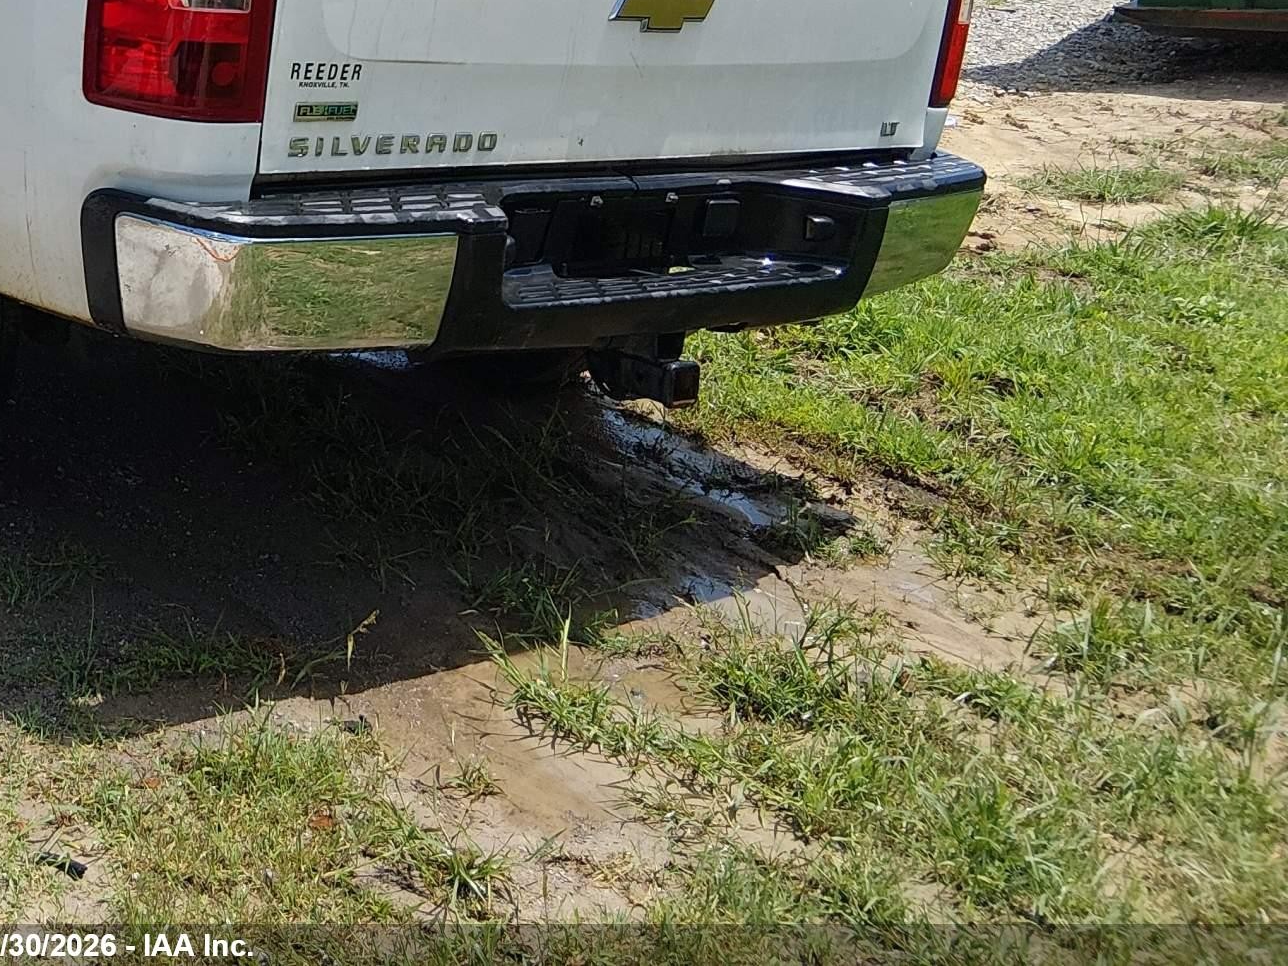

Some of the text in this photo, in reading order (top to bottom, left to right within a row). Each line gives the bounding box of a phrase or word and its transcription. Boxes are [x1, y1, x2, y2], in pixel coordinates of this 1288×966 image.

[290, 62, 362, 81] REEDER
[298, 81, 337, 89] KNOXVILLE,
[880, 121, 900, 137] LT
[288, 131, 498, 157] SILVERADO
